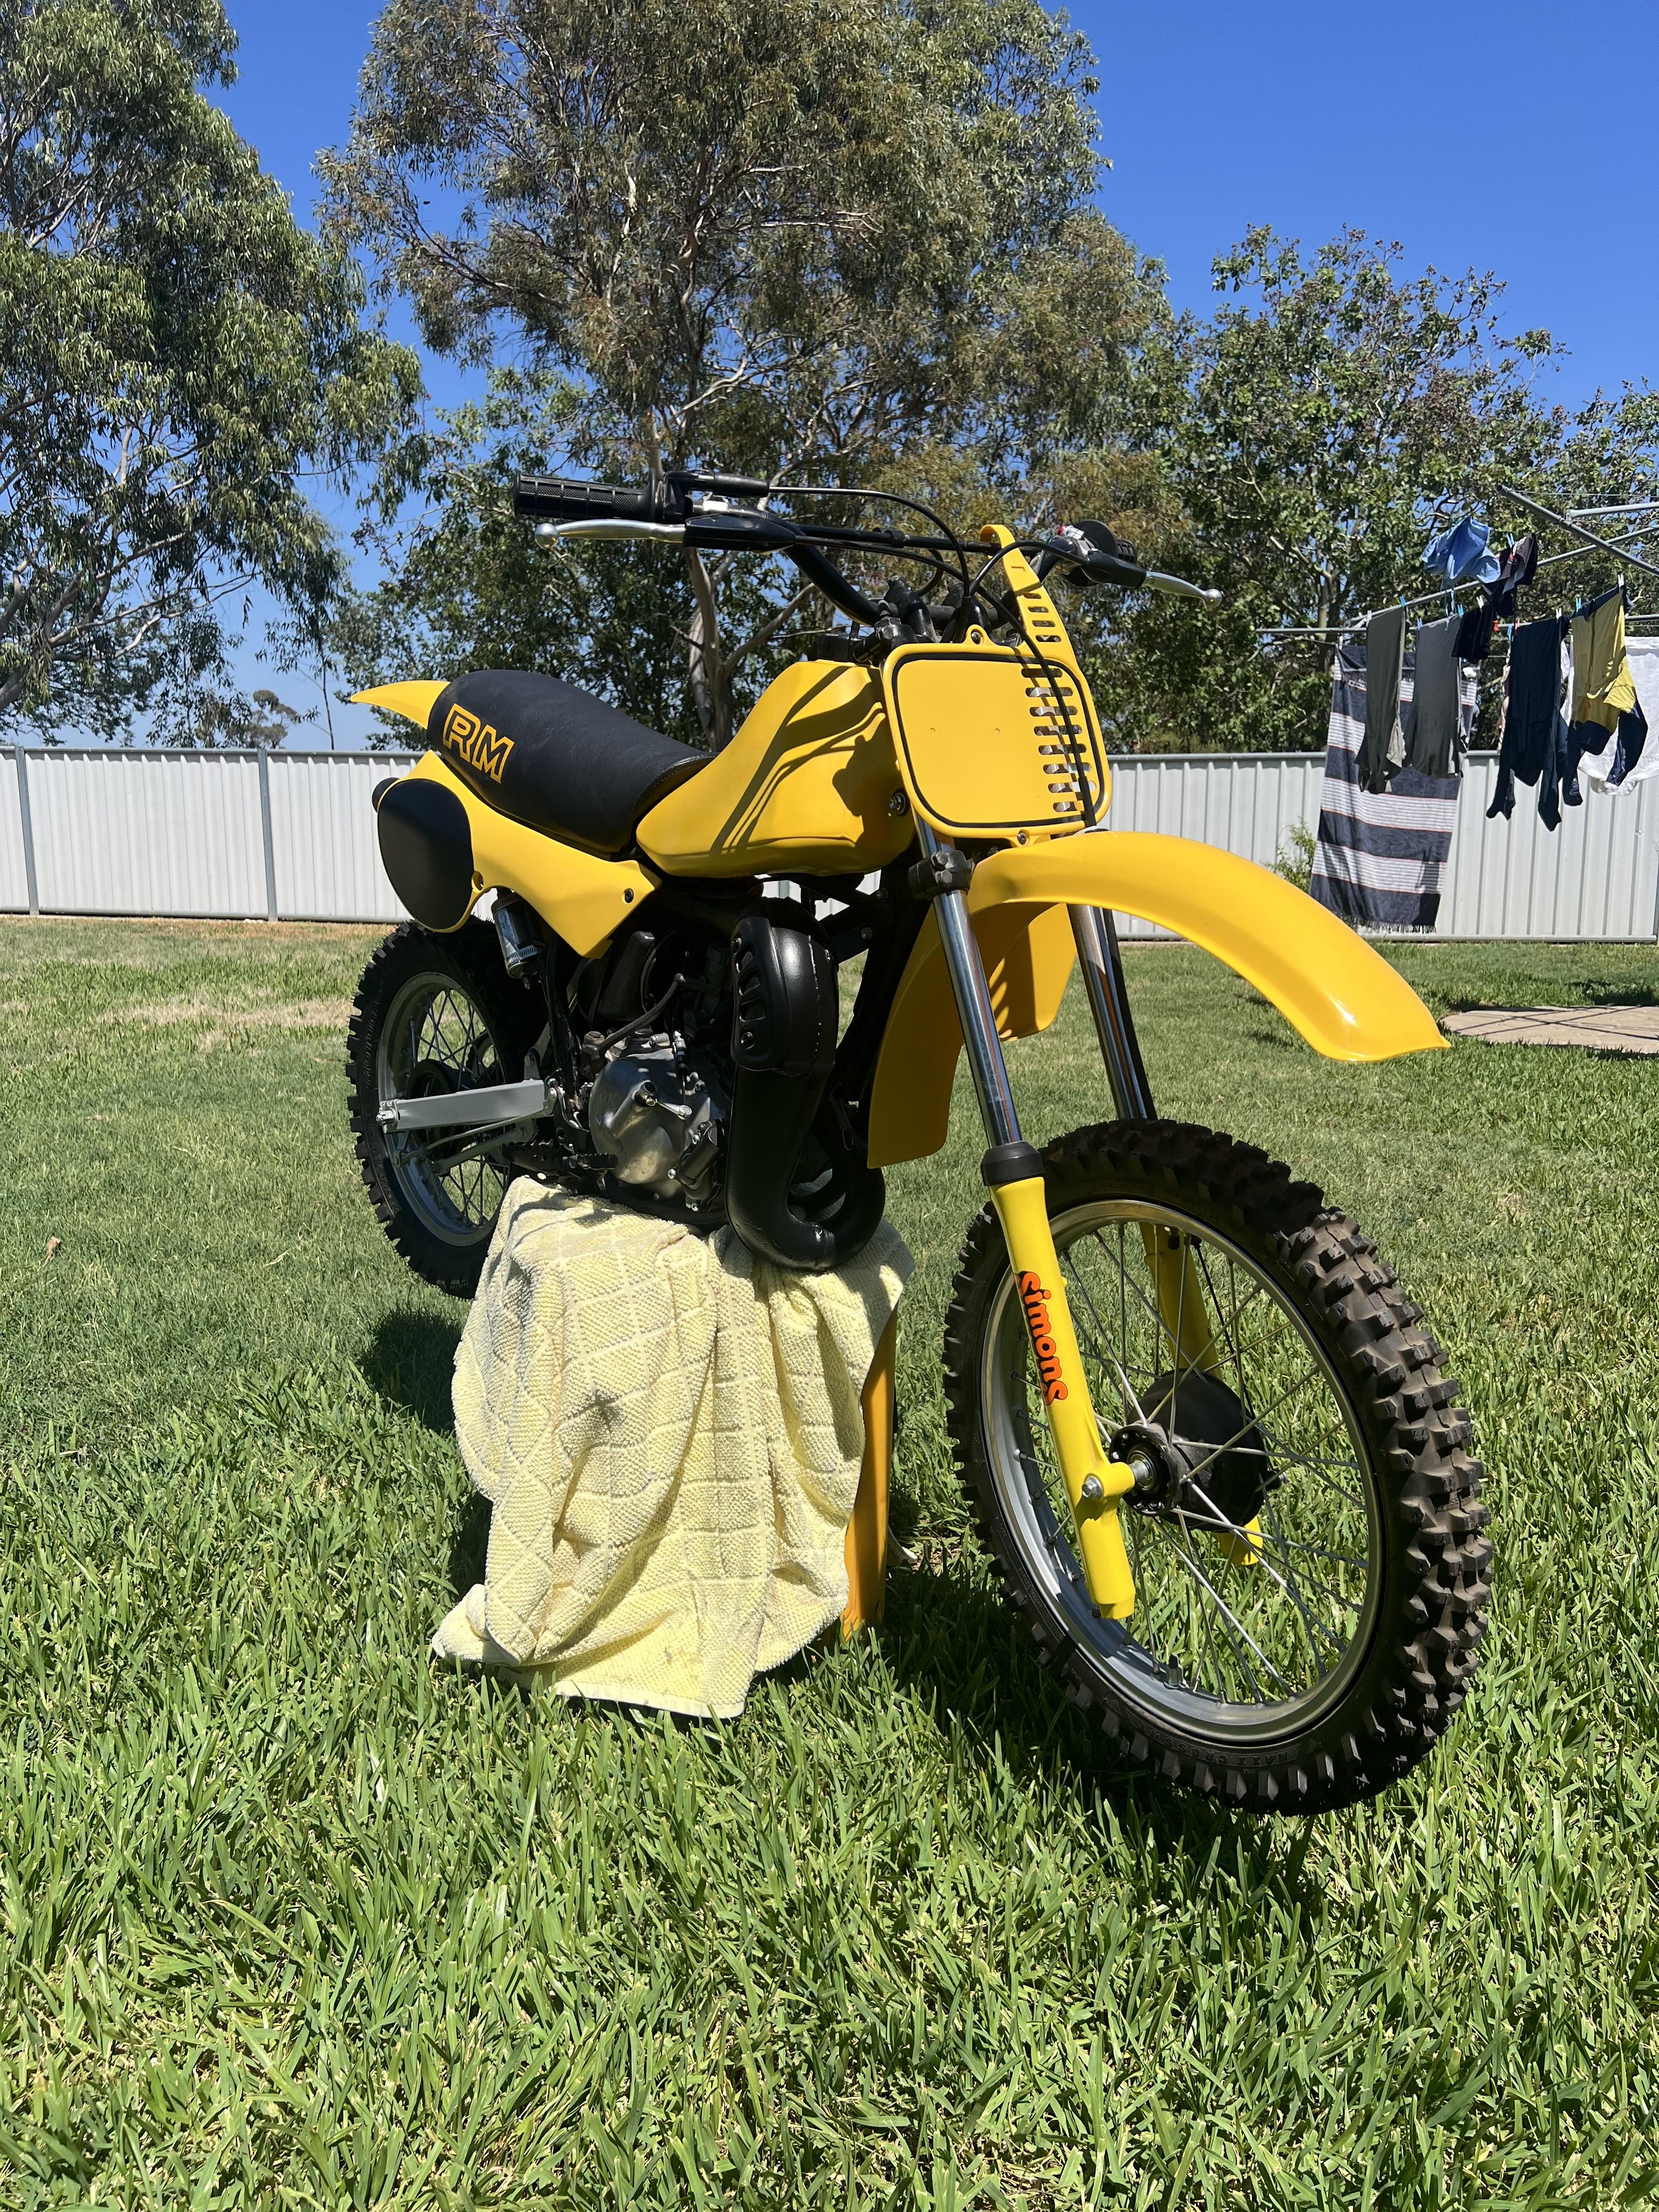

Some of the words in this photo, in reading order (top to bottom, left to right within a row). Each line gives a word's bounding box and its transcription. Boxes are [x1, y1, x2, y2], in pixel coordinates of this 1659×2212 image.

[443, 703, 515, 784] RM
[1015, 1271, 1068, 1406] simons
[1164, 1737, 1228, 1764] CROSS
